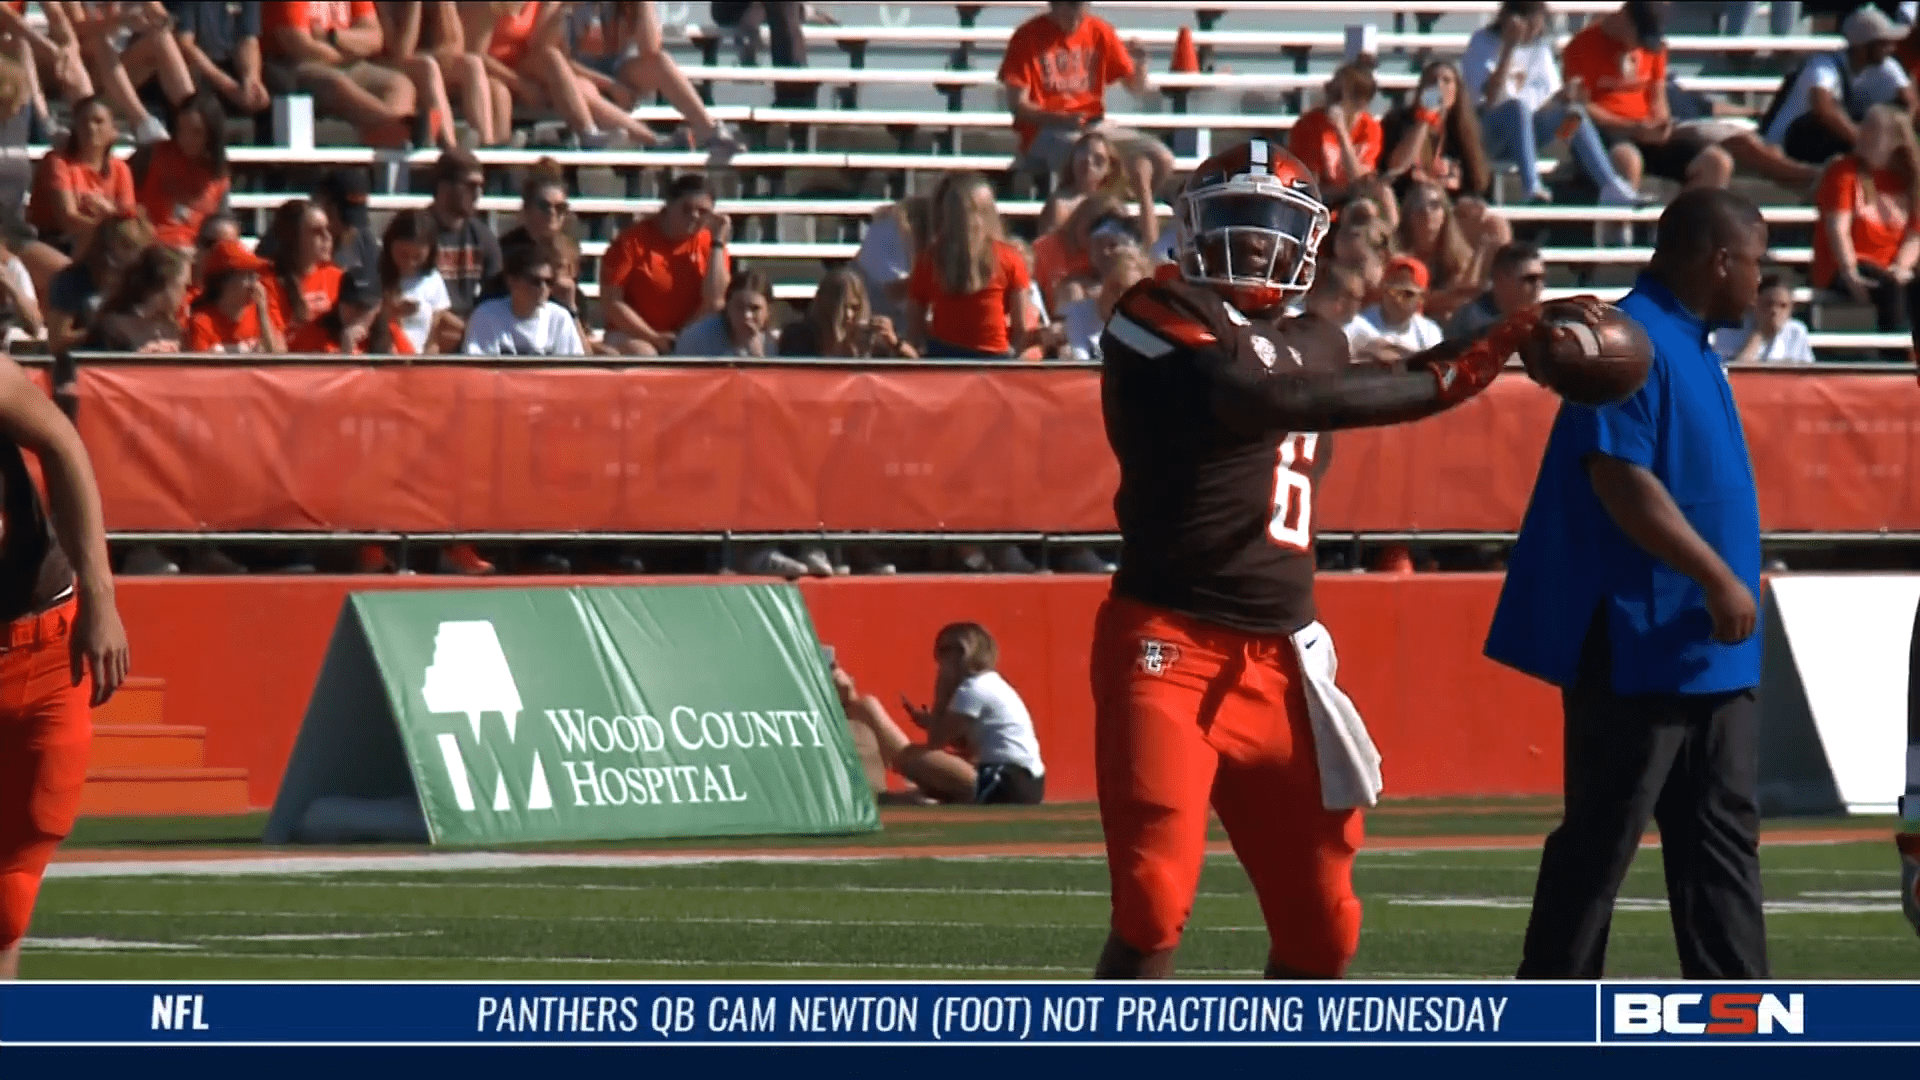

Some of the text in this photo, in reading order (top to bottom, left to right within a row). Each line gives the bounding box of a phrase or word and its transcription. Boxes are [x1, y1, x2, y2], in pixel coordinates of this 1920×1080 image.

[1268, 431, 1320, 550] 6
[544, 705, 824, 753] WOOD COUNTY
[561, 761, 747, 806] HOSPITAL
